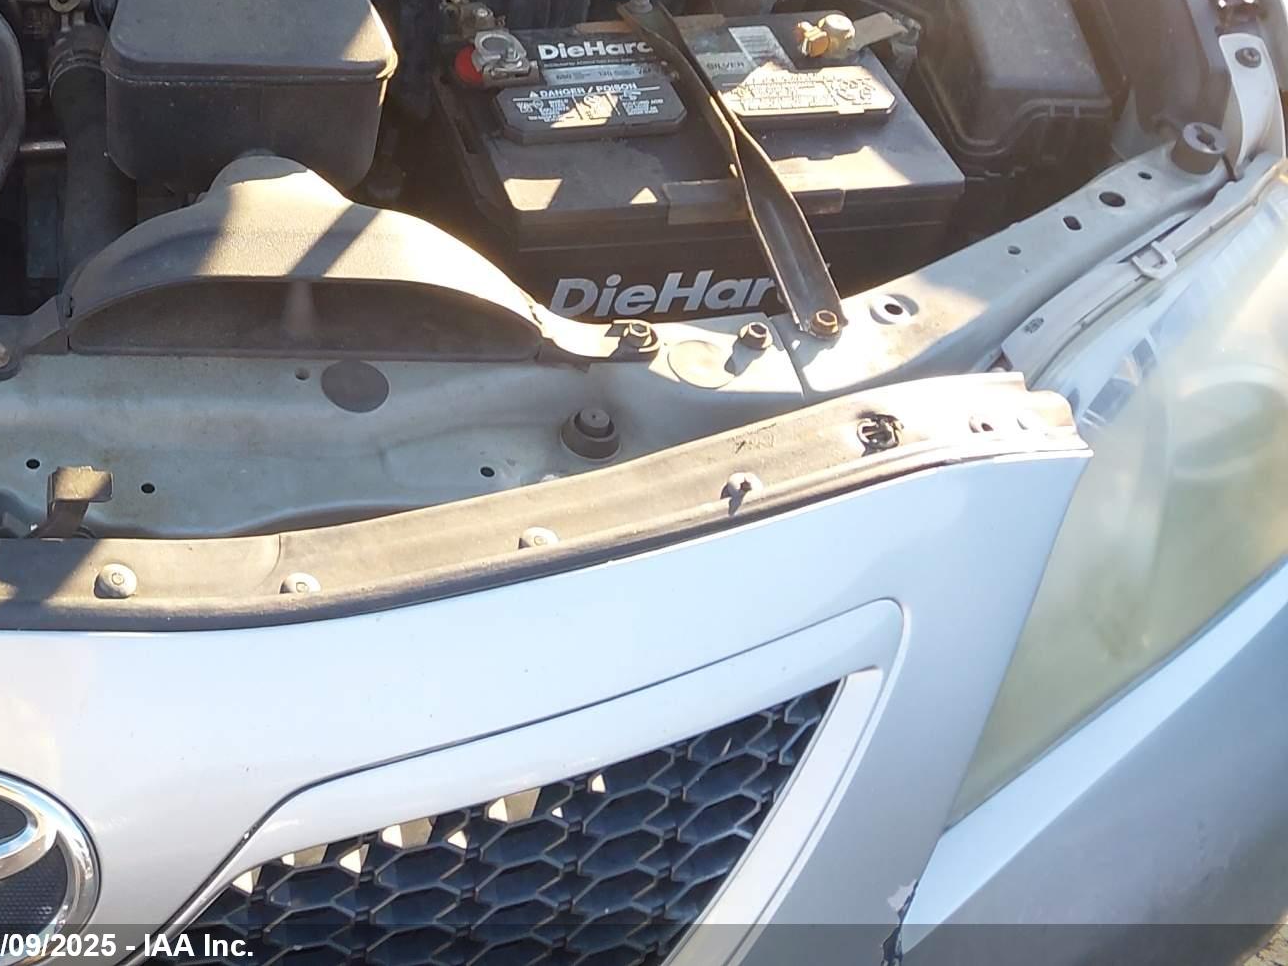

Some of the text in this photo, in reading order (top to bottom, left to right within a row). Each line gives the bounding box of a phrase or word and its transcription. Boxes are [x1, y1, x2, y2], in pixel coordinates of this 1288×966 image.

[539, 87, 586, 99] DANGER
[596, 83, 638, 94] POISON
[549, 269, 779, 318] DieHar
